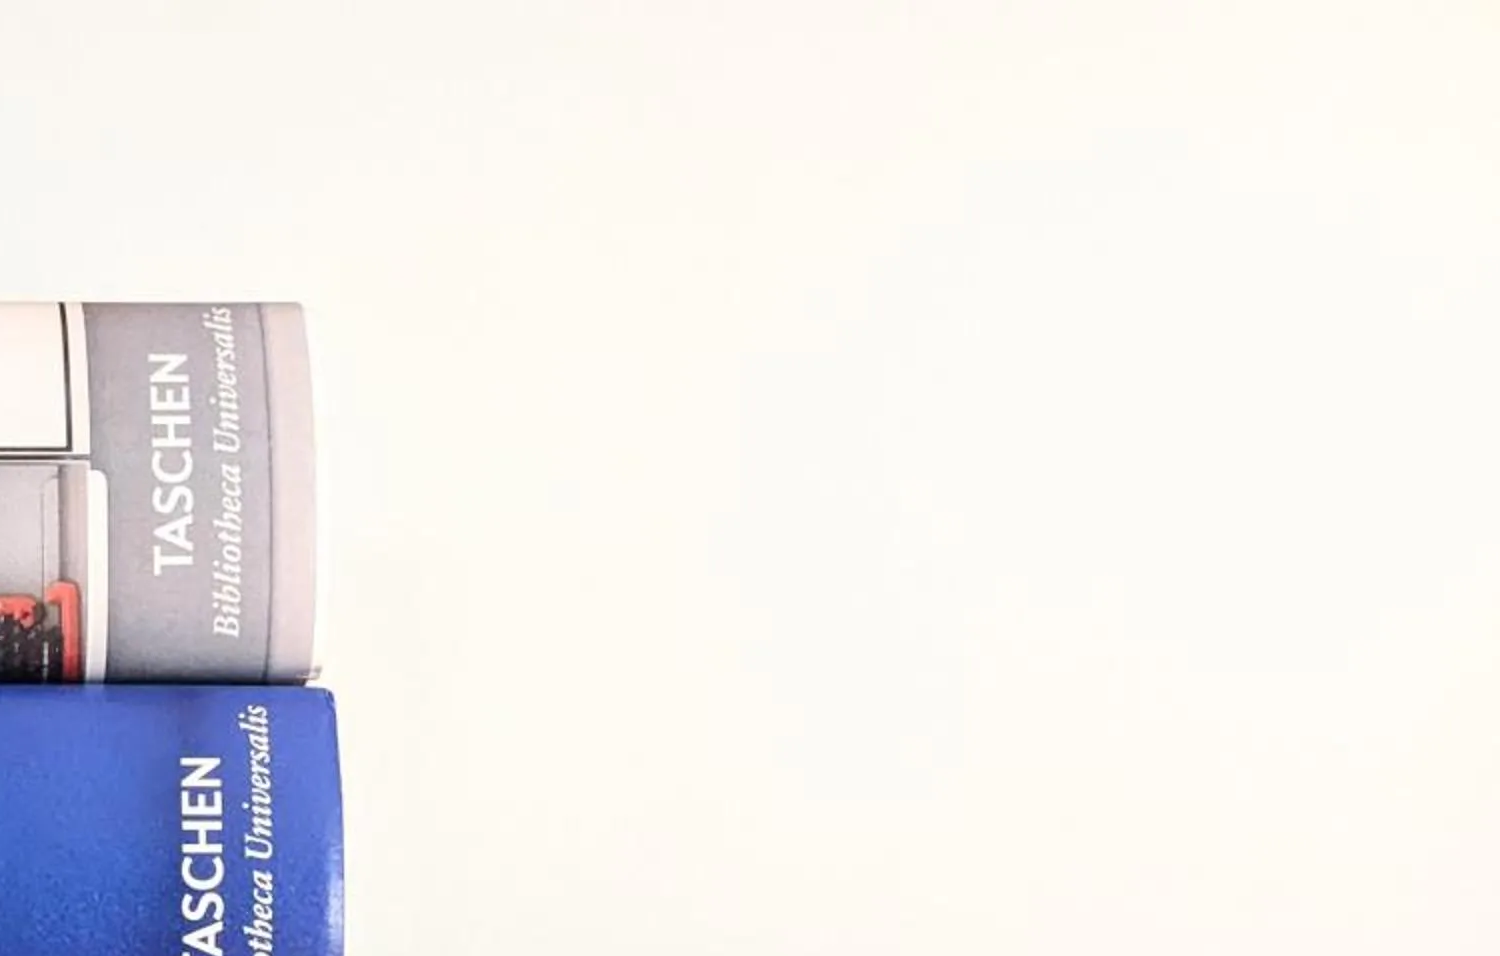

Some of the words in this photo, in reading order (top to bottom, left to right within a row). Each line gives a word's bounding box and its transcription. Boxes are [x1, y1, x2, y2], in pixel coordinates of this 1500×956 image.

[202, 306, 241, 453] Universalis
[148, 353, 194, 575] TASCHEN
[213, 464, 241, 638] Bibliotheca
[238, 704, 273, 861] Universalis
